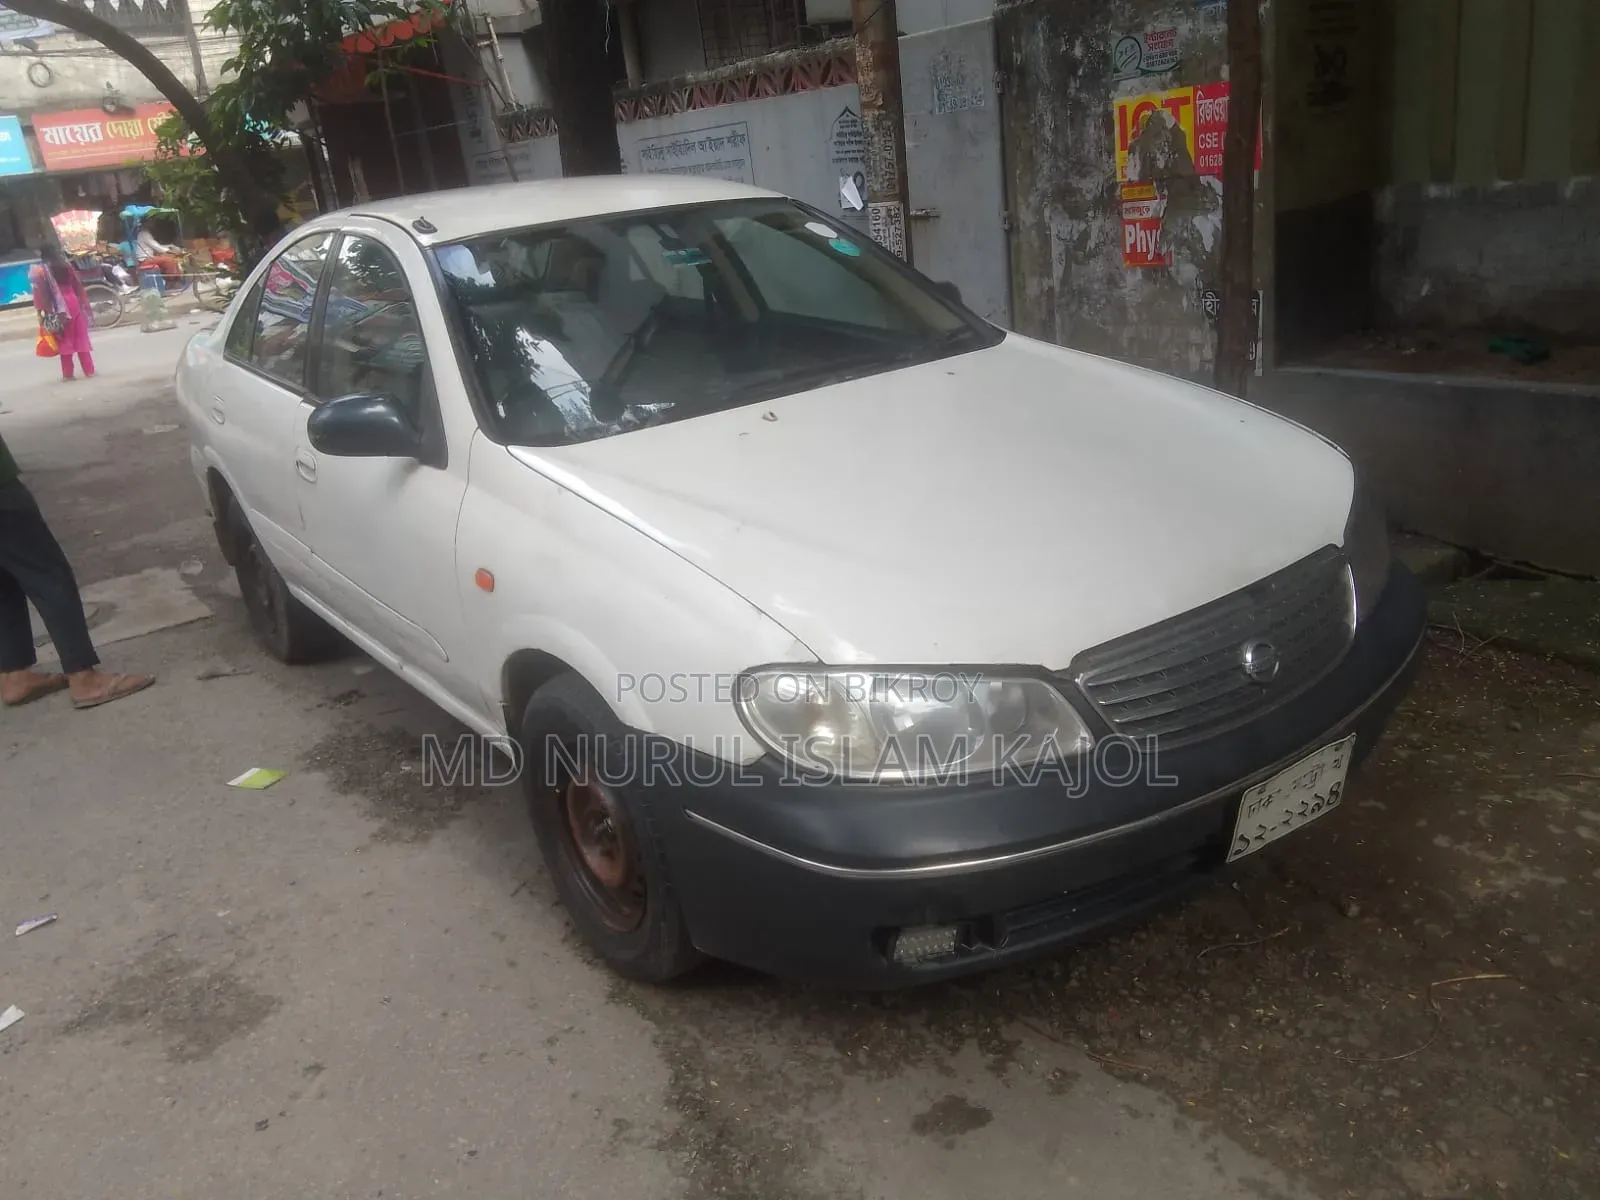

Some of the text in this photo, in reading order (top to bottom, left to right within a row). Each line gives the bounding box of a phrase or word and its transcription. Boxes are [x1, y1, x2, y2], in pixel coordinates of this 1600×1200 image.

[40, 122, 104, 146] মায়ের
[106, 118, 144, 140] দোয়া
[1198, 132, 1218, 149] CSE
